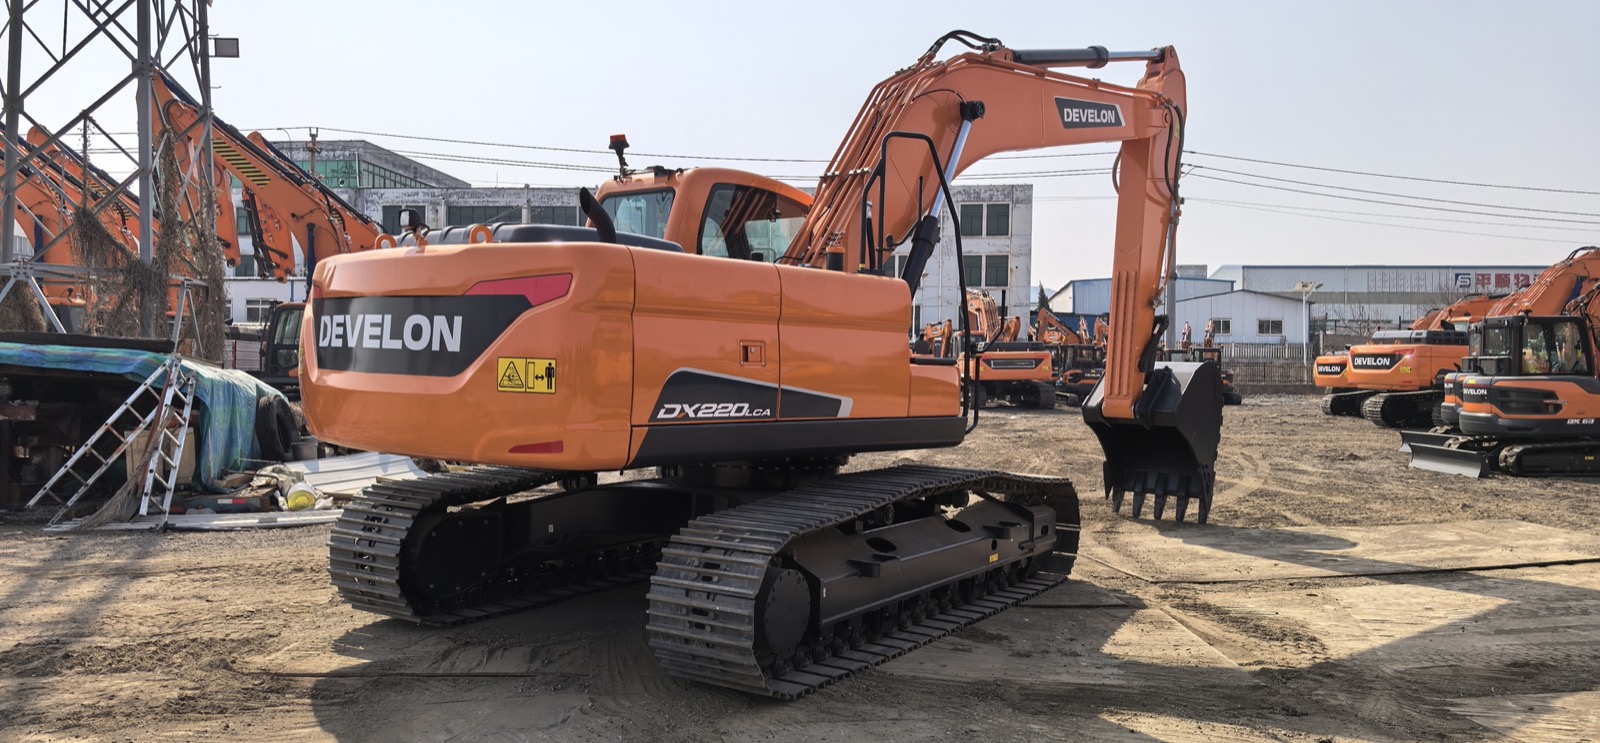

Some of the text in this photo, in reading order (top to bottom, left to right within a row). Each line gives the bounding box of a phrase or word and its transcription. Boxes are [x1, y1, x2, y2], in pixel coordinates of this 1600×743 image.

[1063, 108, 1115, 124] DEVELON
[1475, 273, 1540, 288] 平顺物
[318, 314, 463, 352] DEVELON
[1354, 357, 1390, 366] DEVELON
